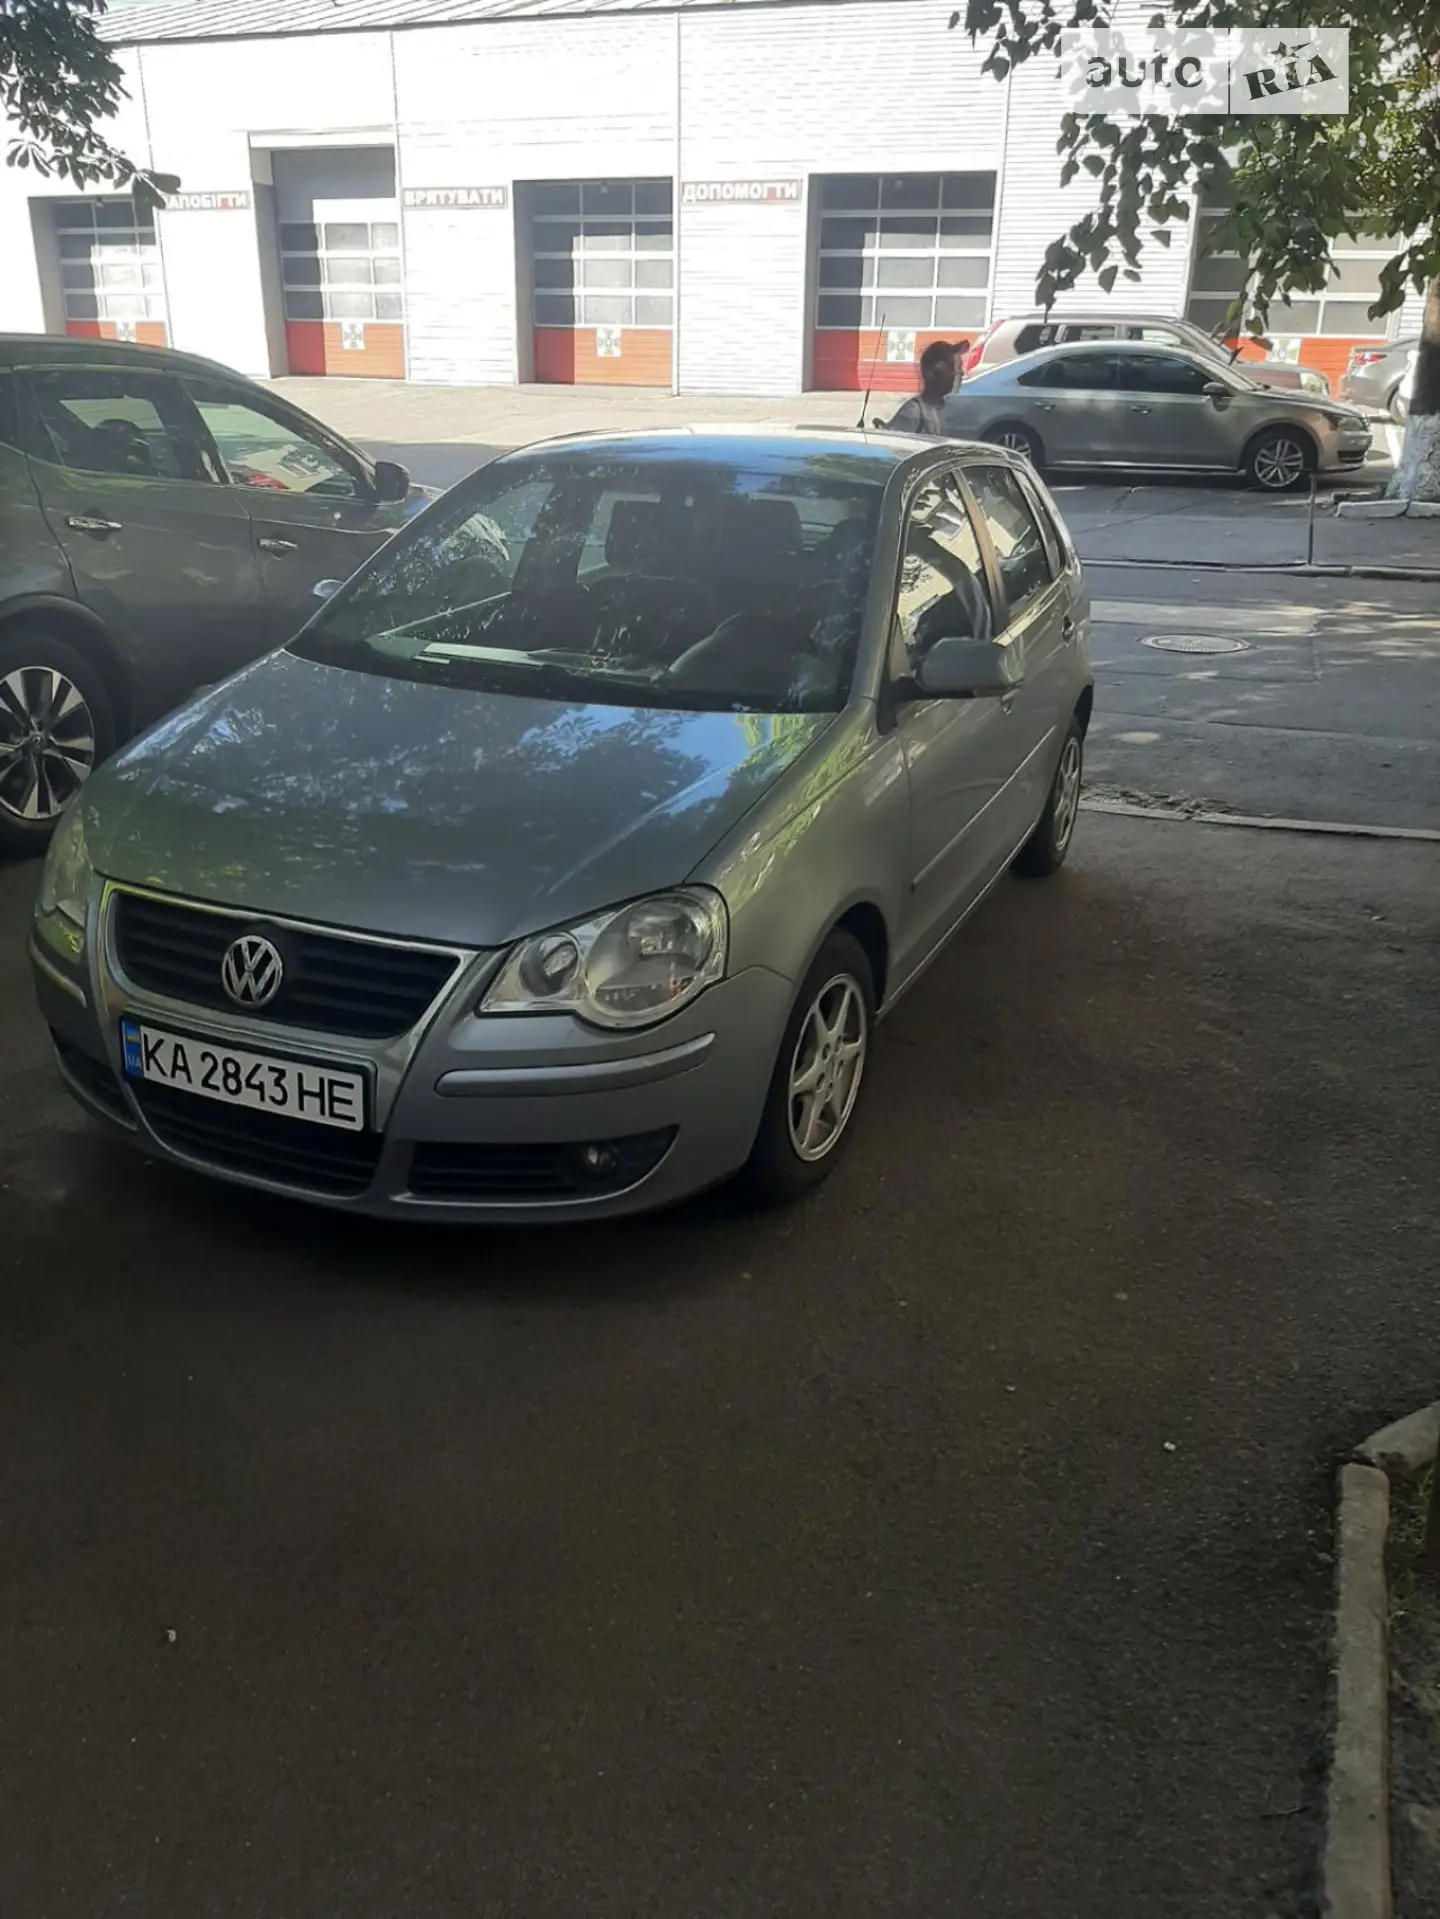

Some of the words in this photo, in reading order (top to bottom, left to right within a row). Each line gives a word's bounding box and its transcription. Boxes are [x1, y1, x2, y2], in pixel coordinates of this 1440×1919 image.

[163, 193, 247, 209] АПОБІГТИ
[404, 188, 504, 206] ВРЯТУВАТИ
[683, 181, 798, 203] ДОПОМОГТИ
[143, 1033, 193, 1085] KA
[201, 1051, 288, 1106] 2843
[298, 1071, 357, 1123] HE
